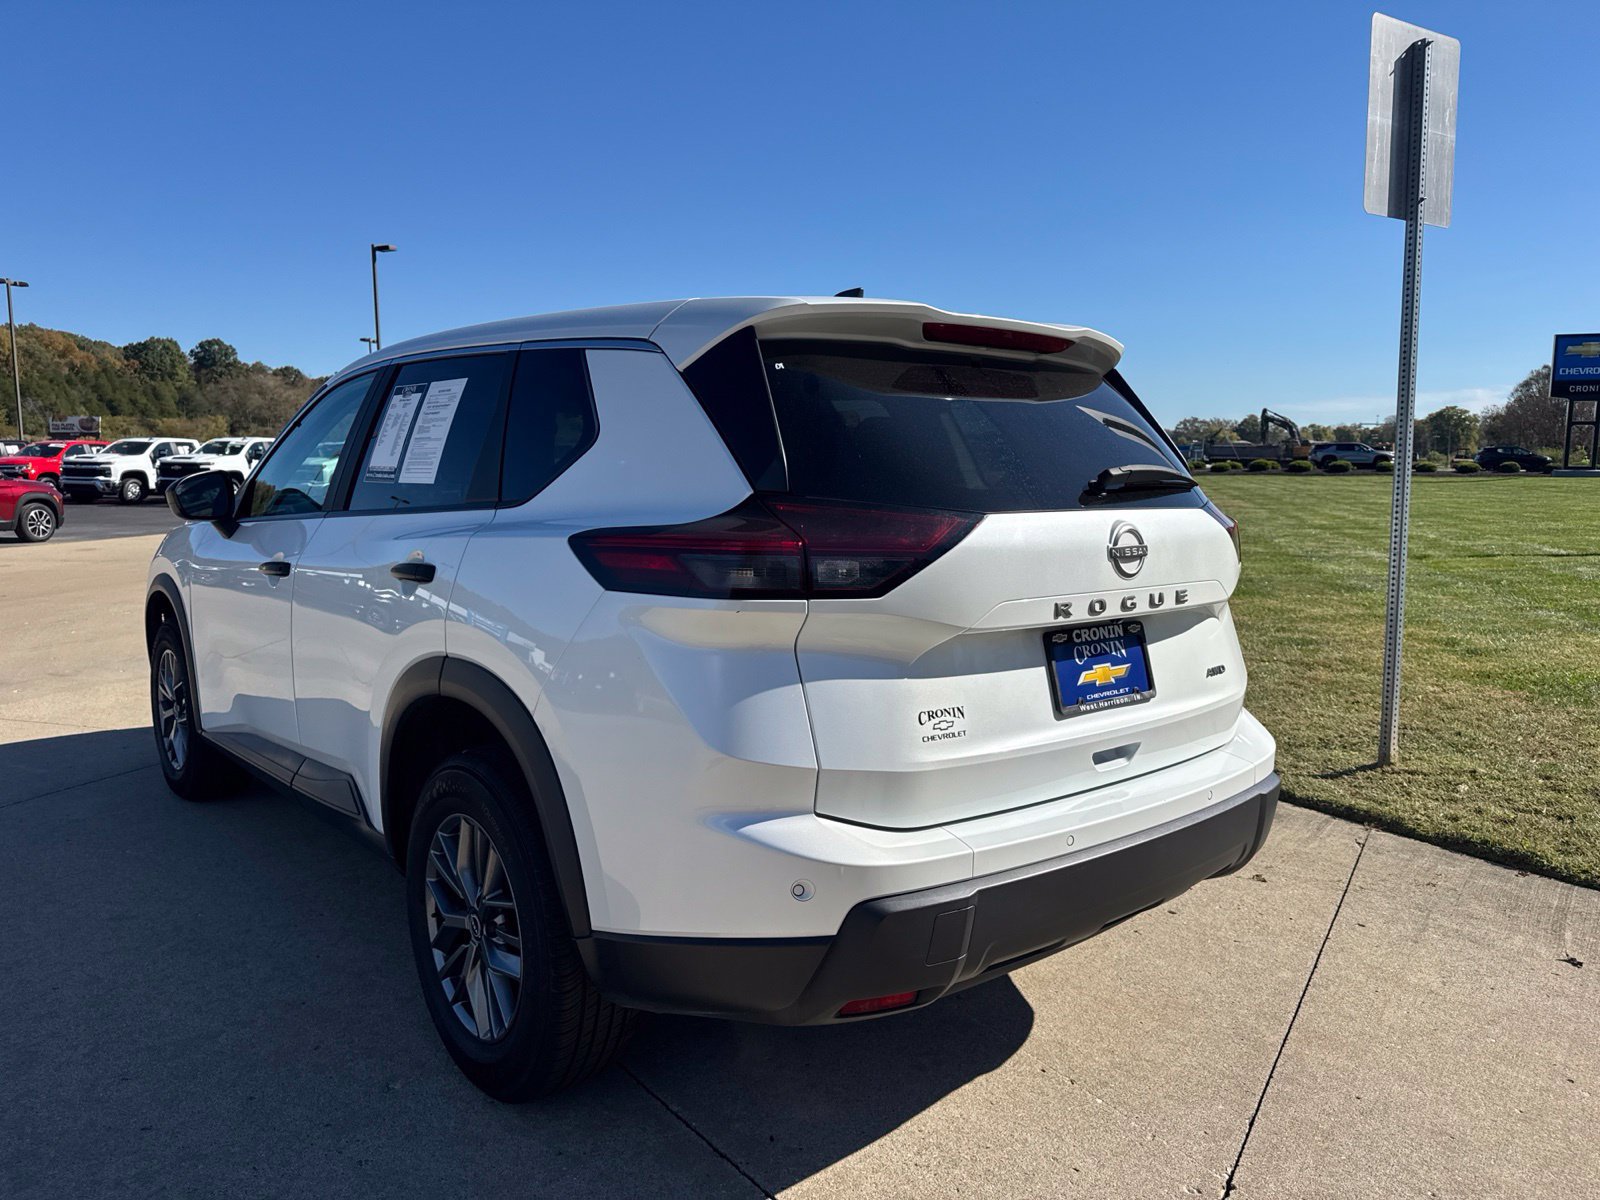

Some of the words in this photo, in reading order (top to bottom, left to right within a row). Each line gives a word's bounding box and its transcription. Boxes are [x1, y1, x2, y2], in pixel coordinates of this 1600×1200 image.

[1112, 547, 1148, 557] NISSAN
[1053, 589, 1188, 620] ROGUE
[1072, 624, 1124, 643] CRONIN
[1074, 639, 1127, 665] CRONIN
[1206, 664, 1226, 678] AWD
[1079, 701, 1098, 712] West
[1133, 693, 1142, 701] IN
[1086, 687, 1130, 700] CHEVROLET
[918, 705, 965, 726] CRONIN
[922, 730, 966, 742] CHEVROLET
